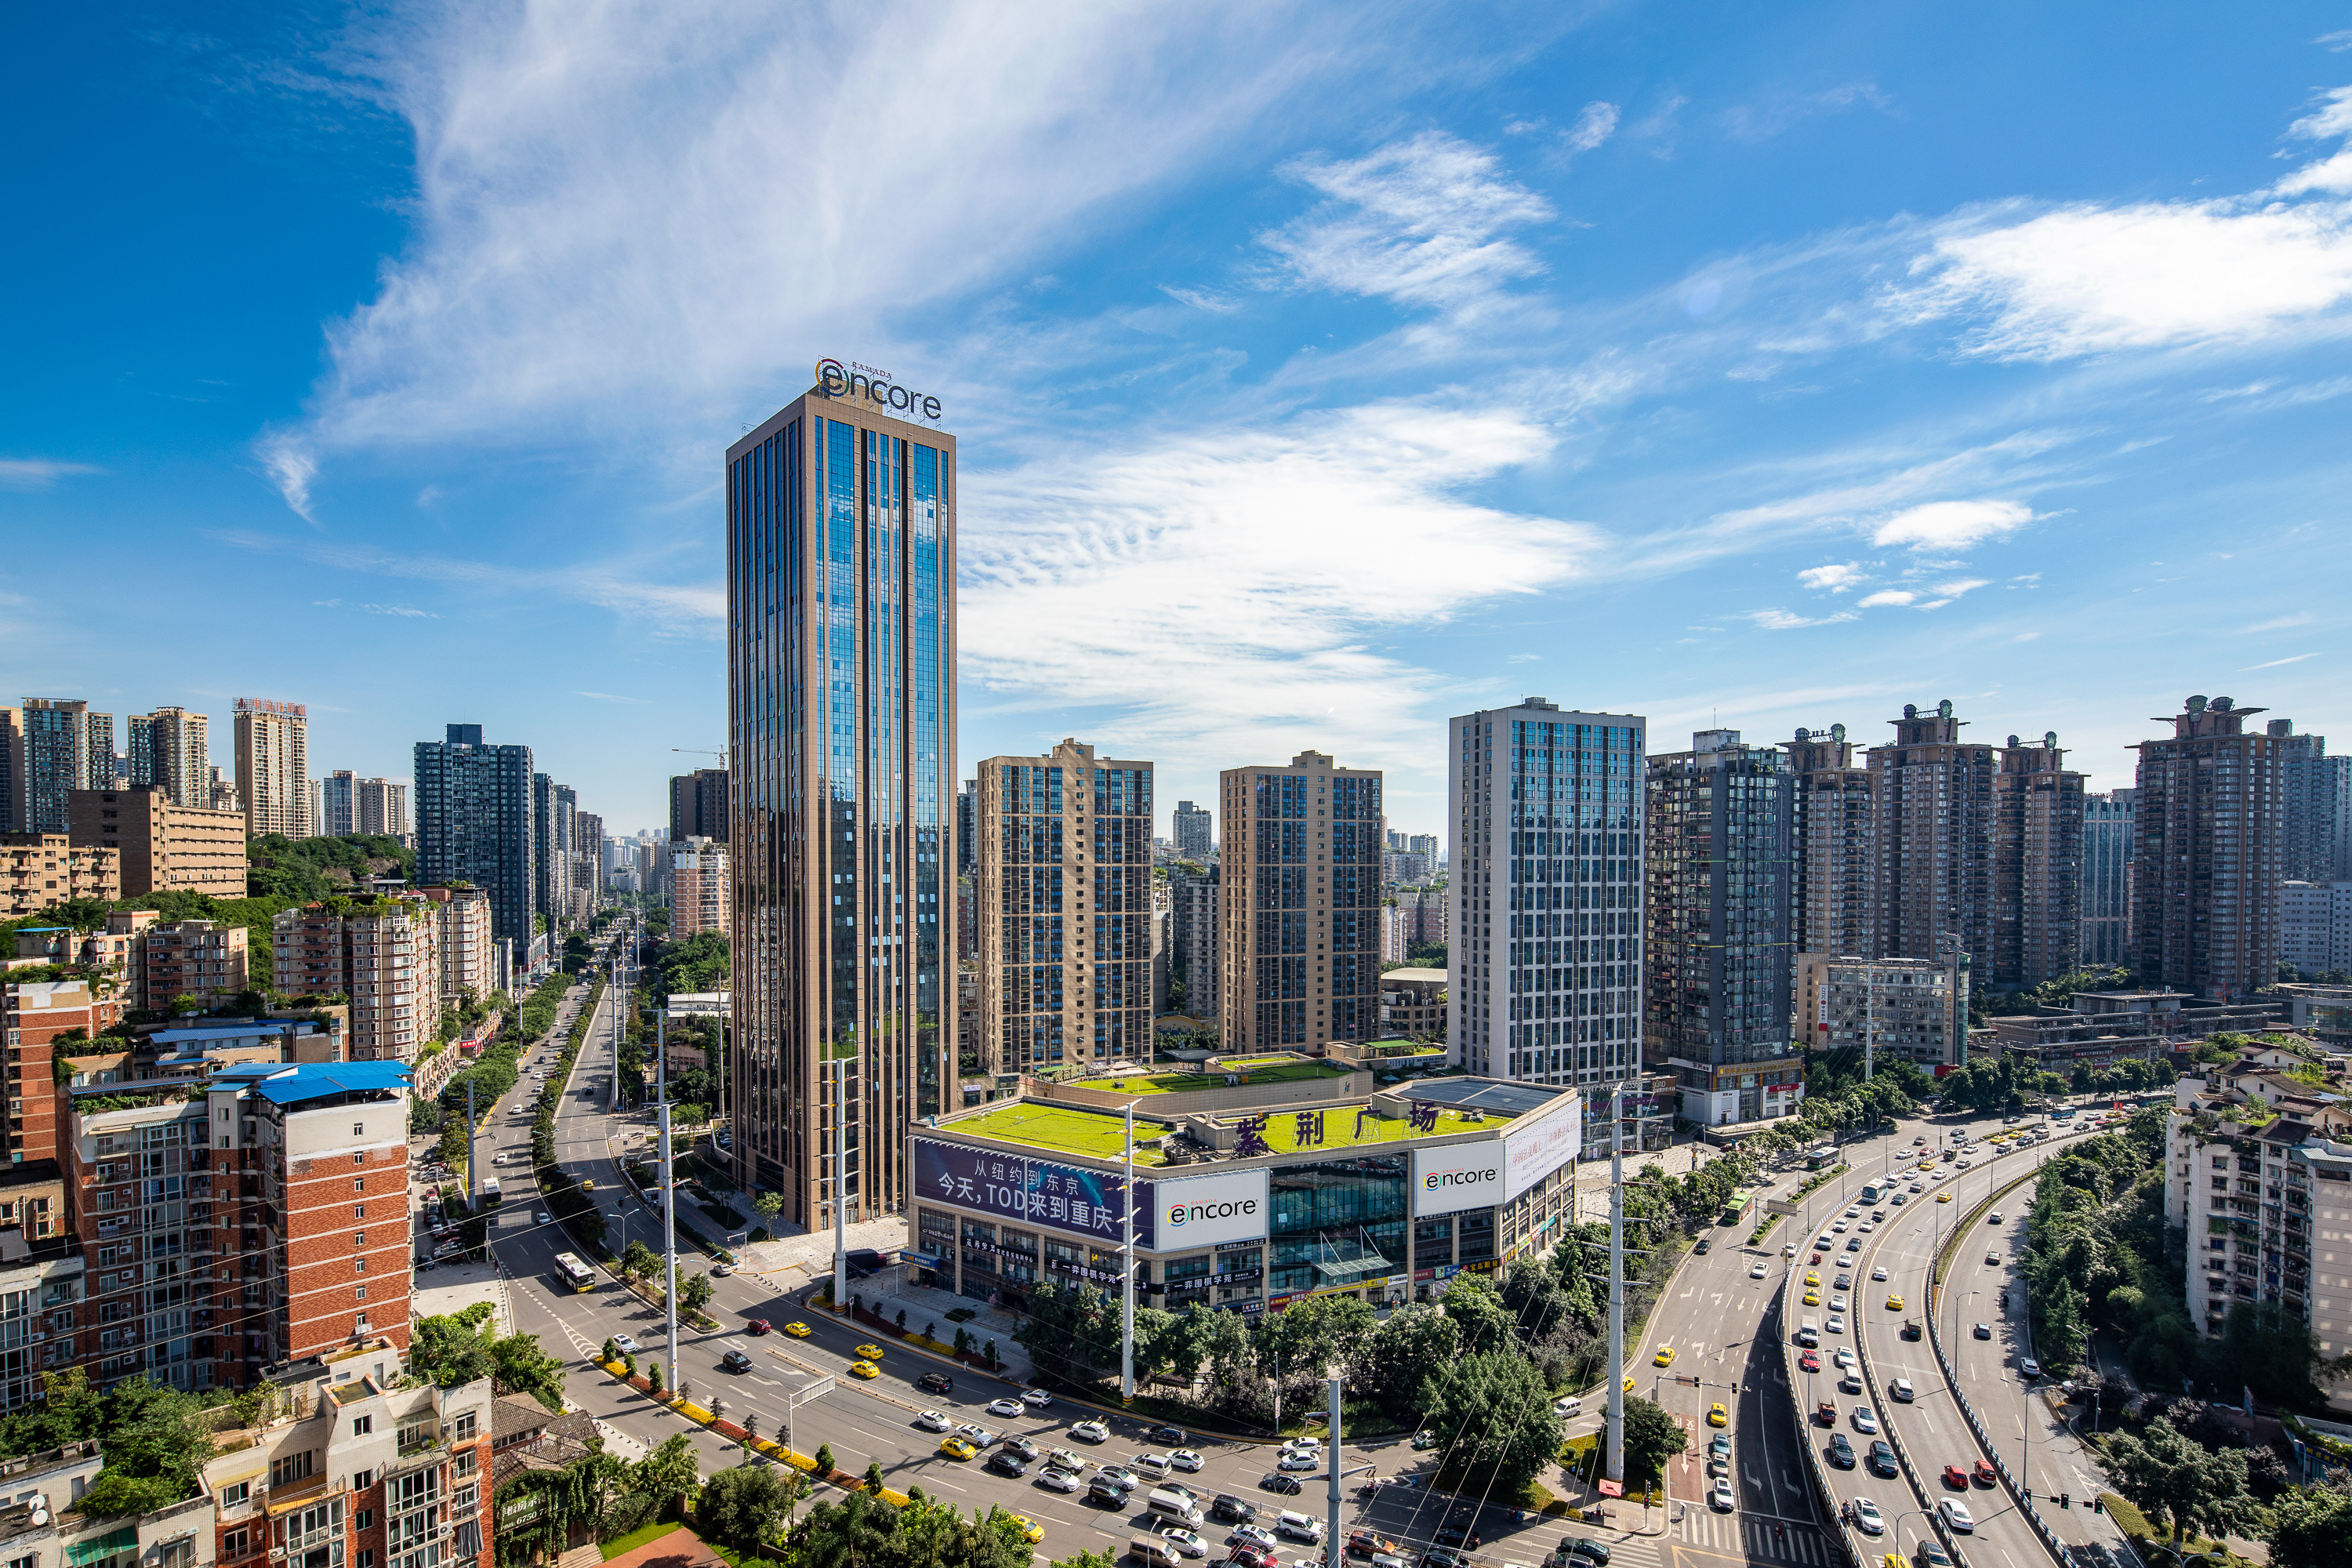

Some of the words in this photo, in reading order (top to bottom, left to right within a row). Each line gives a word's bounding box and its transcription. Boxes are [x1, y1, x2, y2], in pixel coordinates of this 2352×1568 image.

[852, 361, 892, 379] RAMADA
[822, 365, 942, 419] encore
[1236, 1101, 1436, 1153] 紫荆广场
[974, 1159, 1080, 1196] 从纽约到东京
[1427, 1168, 1496, 1188] encore
[1171, 1200, 1256, 1223] encore
[1062, 1265, 1116, 1283] 一弈围棋学苑
[1174, 1274, 1232, 1290] 一弈围棋学苑
[516, 1511, 537, 1525] 6750
